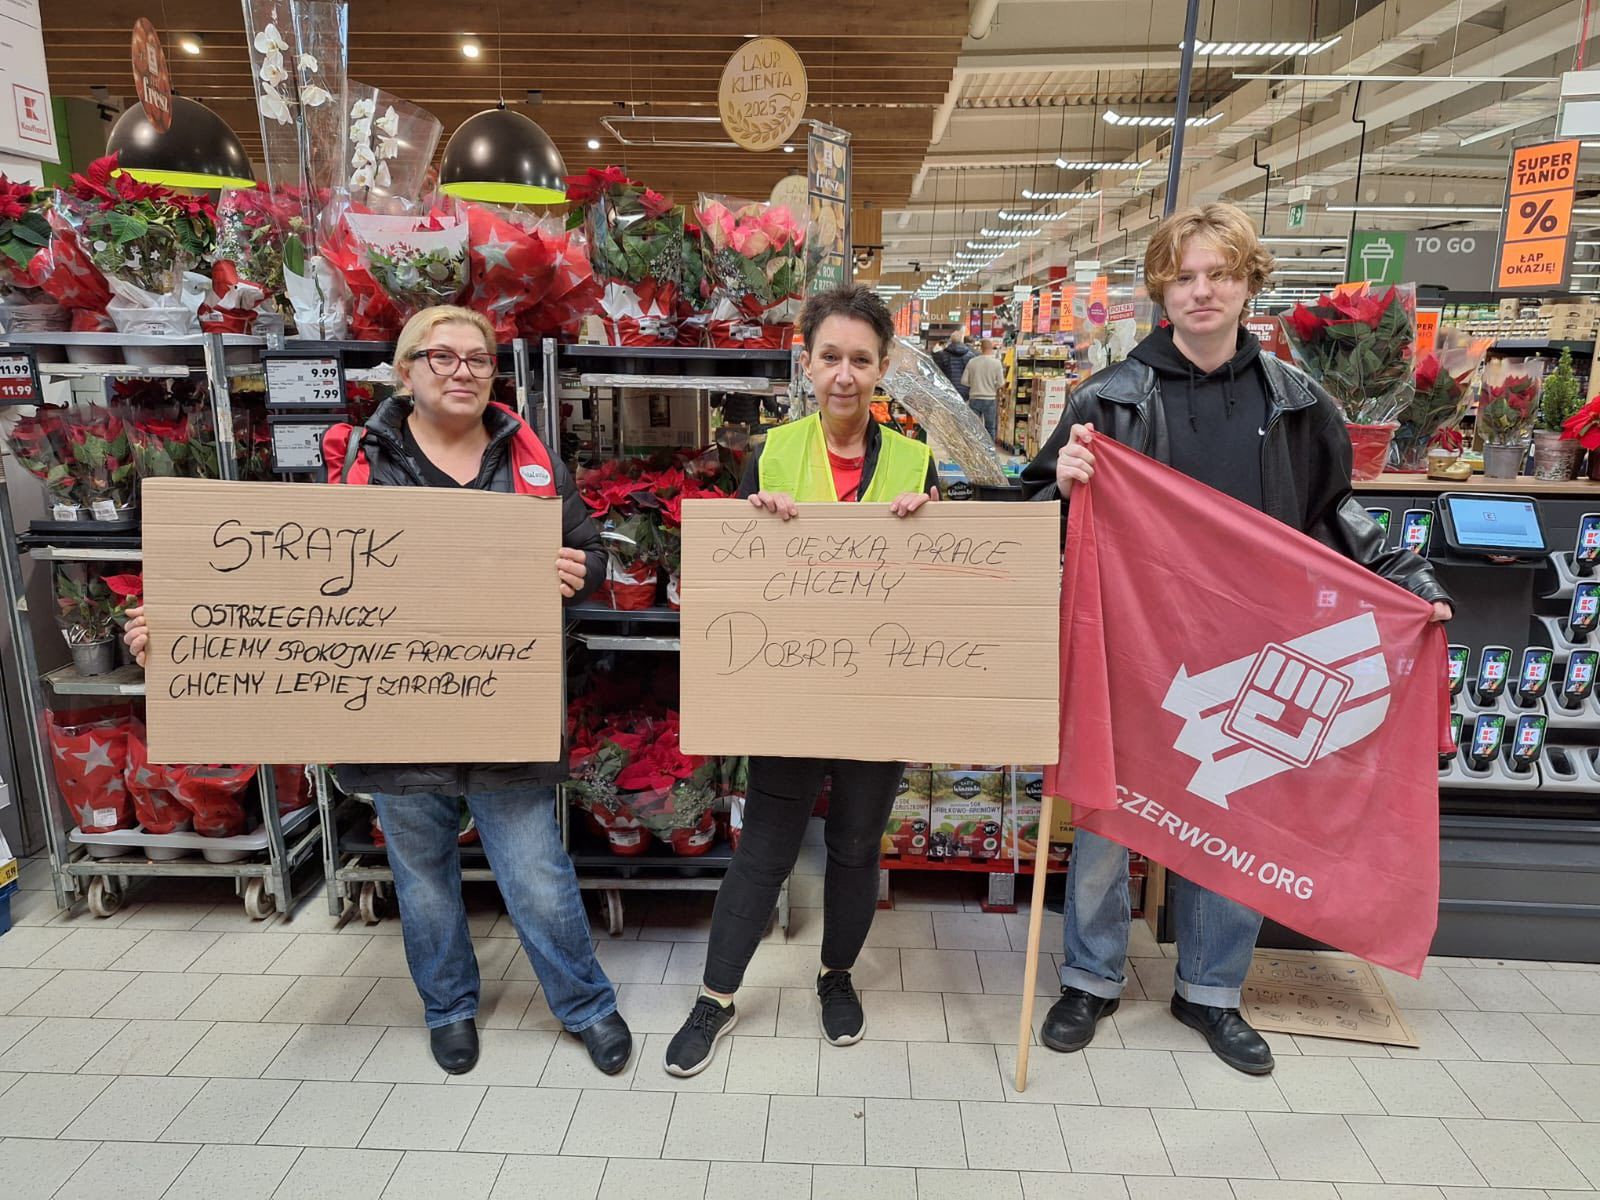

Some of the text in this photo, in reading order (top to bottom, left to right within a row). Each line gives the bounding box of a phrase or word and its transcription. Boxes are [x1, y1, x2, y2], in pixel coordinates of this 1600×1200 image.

[732, 71, 792, 94] KLIENTA
[743, 98, 777, 118] 2025
[1517, 152, 1572, 172] SUPER
[1517, 167, 1570, 185] TANIO
[1415, 237, 1476, 253] TO GO
[1520, 253, 1544, 264] ŁAP
[1506, 263, 1556, 275] OKAZJĘ!
[1109, 302, 1134, 313] POLSKI
[1416, 323, 1434, 331] PER
[0, 364, 29, 375] 11.99
[311, 368, 337, 378] 9.99
[2, 385, 32, 396] 11.99
[313, 389, 339, 399] 7.99
[712, 519, 765, 563] ZA
[907, 532, 1022, 565] PRACE
[209, 519, 404, 597] STRAJK
[763, 568, 906, 604] CHCEMY
[171, 634, 272, 664] CHCEMY
[275, 639, 402, 669] SPOKOJNIE
[169, 669, 498, 711] CHCEMY LEPIEJ ZARABIAĆ
